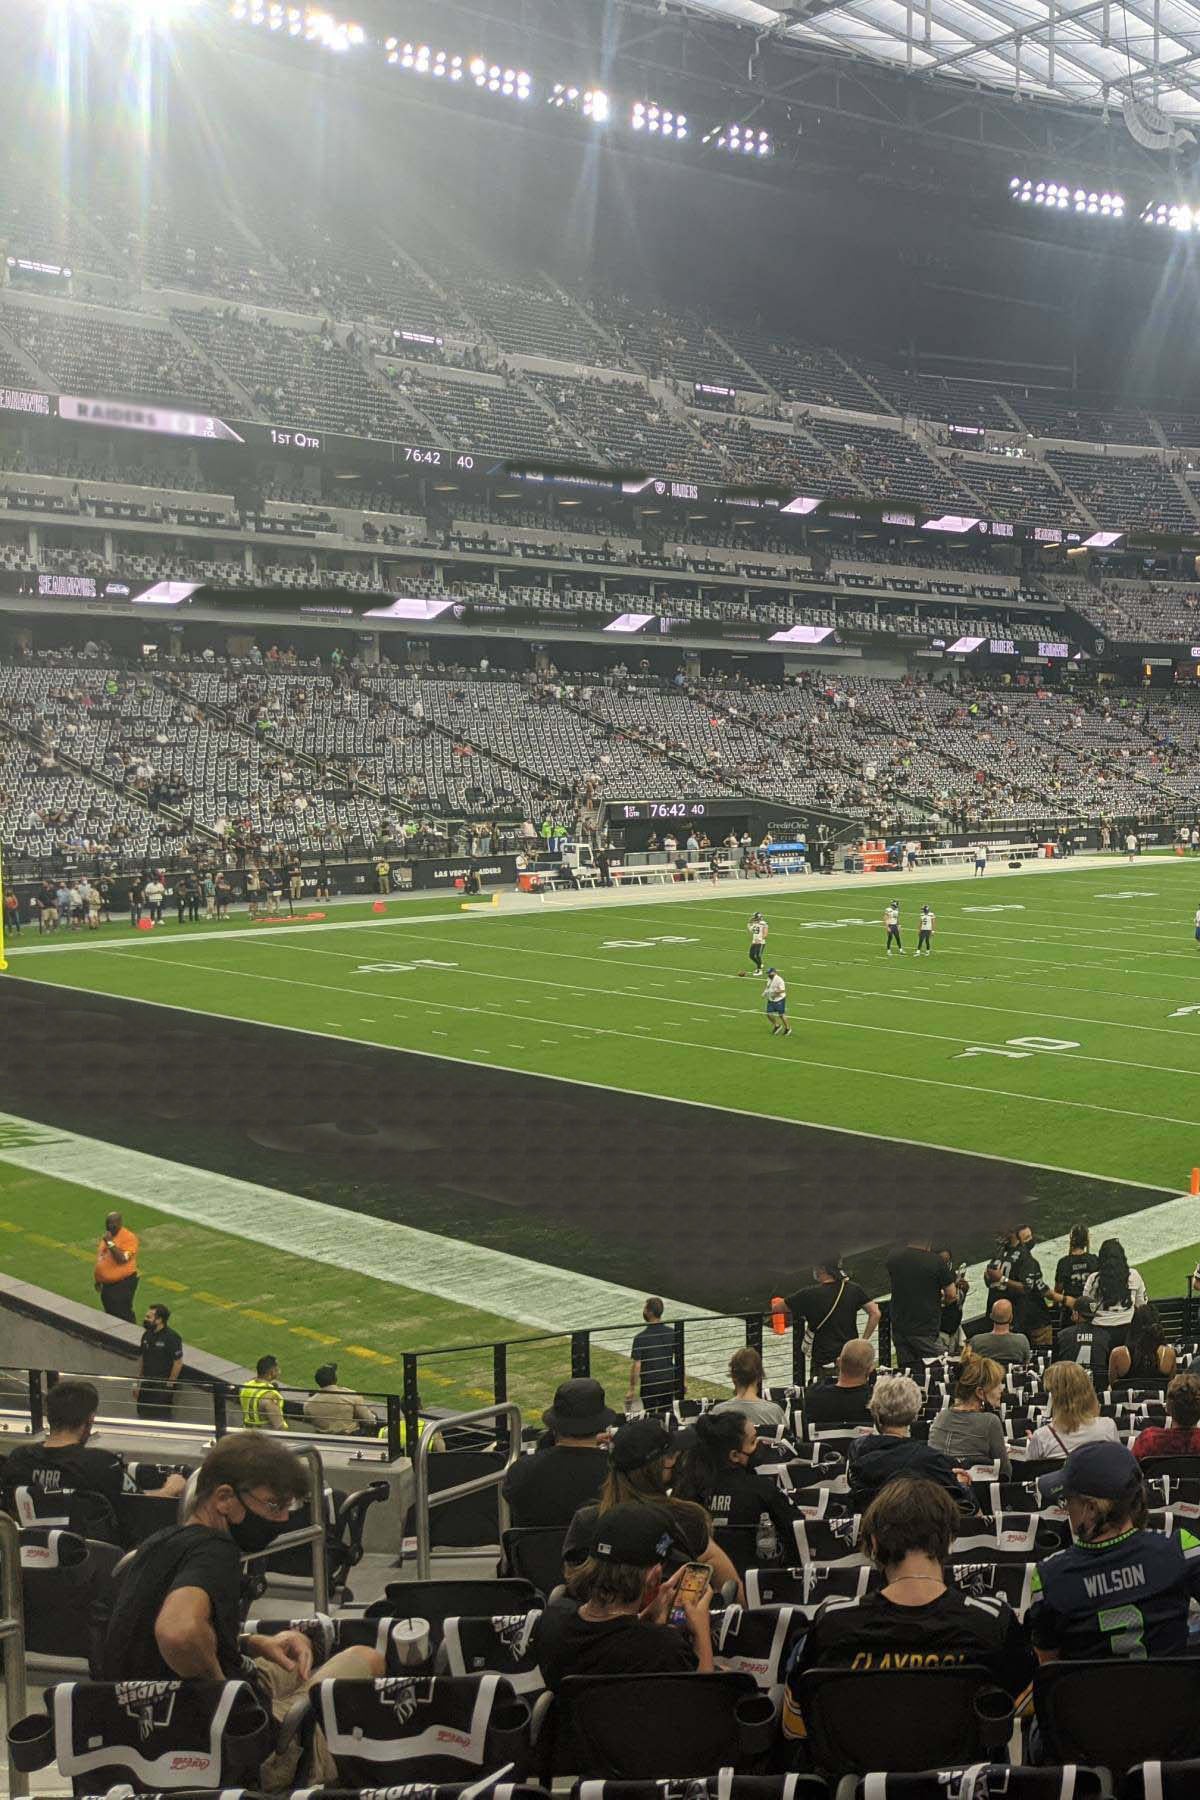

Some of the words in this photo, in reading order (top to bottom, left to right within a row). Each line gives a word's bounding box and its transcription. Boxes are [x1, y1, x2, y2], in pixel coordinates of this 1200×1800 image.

[271, 429, 291, 444] 1ST
[294, 433, 320, 448] QTR
[404, 448, 441, 465] 76:42
[456, 456, 474, 469] 40
[671, 482, 698, 499] RAIDERS
[38, 575, 97, 597] SEAHAWKS
[650, 804, 686, 817] 76:42
[690, 804, 705, 815] 40
[434, 870, 448, 878] LAS
[963, 1036, 1081, 1058] 10
[1076, 1332, 1093, 1342] CARR
[32, 1468, 61, 1489] CARR
[1082, 1563, 1147, 1600] WILSON
[1097, 1604, 1149, 1660] 3
